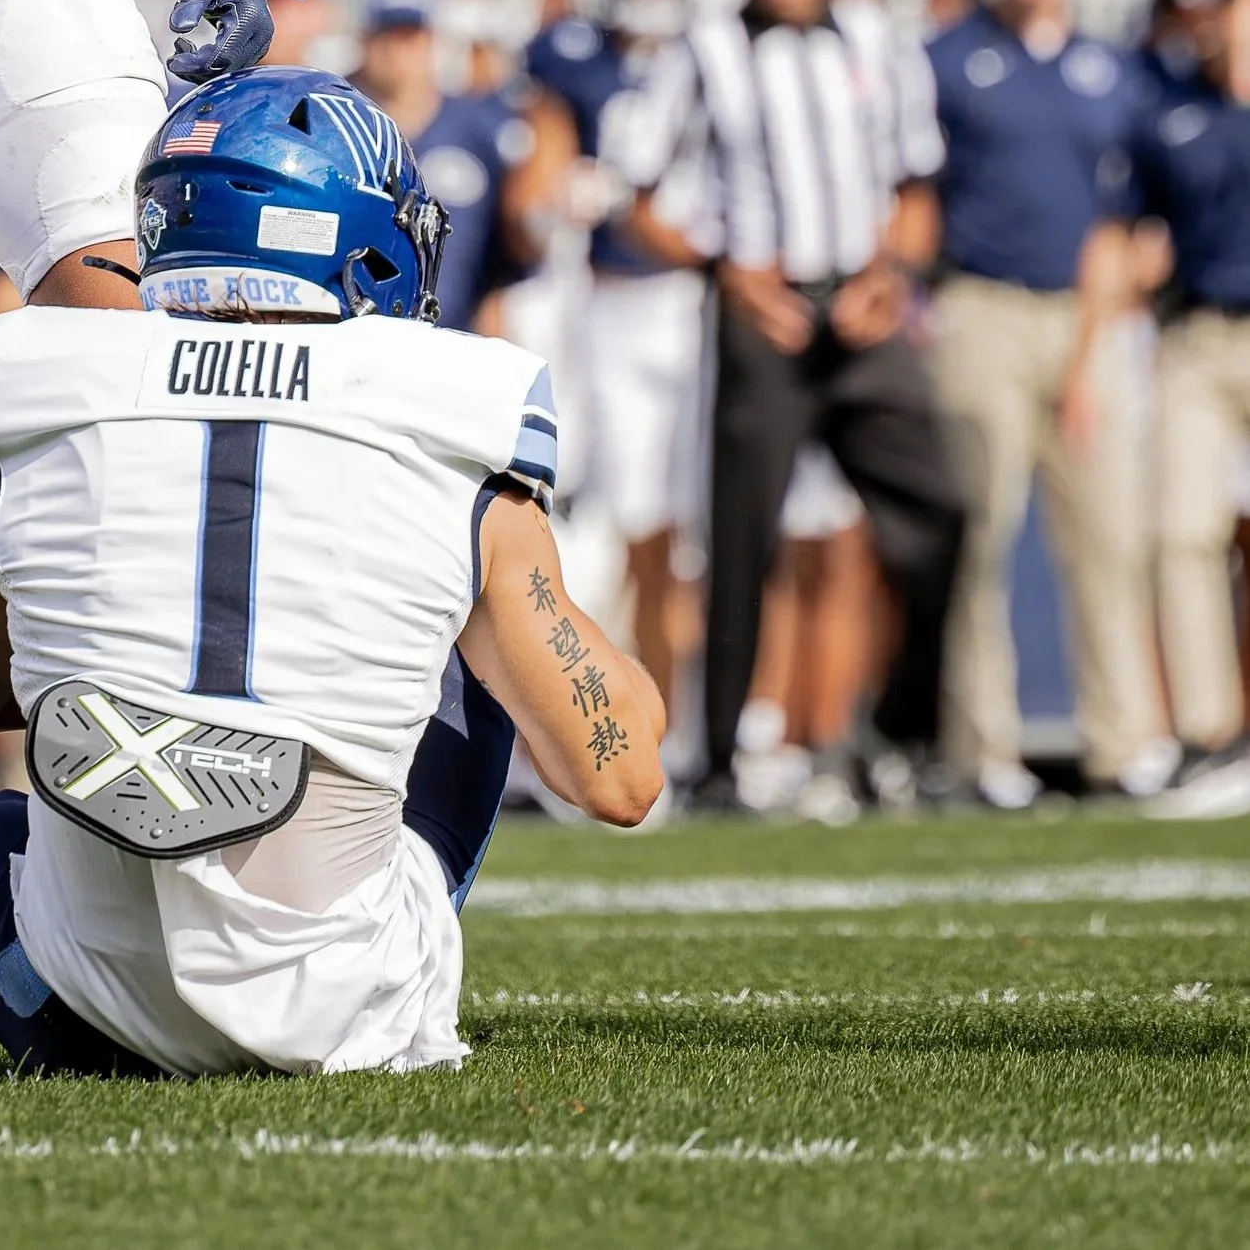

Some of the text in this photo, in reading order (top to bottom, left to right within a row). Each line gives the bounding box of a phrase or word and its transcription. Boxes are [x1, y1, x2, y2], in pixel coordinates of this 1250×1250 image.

[185, 183, 191, 201] 1
[287, 210, 316, 219] WARNING
[162, 277, 210, 305] THE
[224, 277, 302, 306] ROCK
[167, 339, 310, 402] COLELLA
[182, 420, 267, 704] 1
